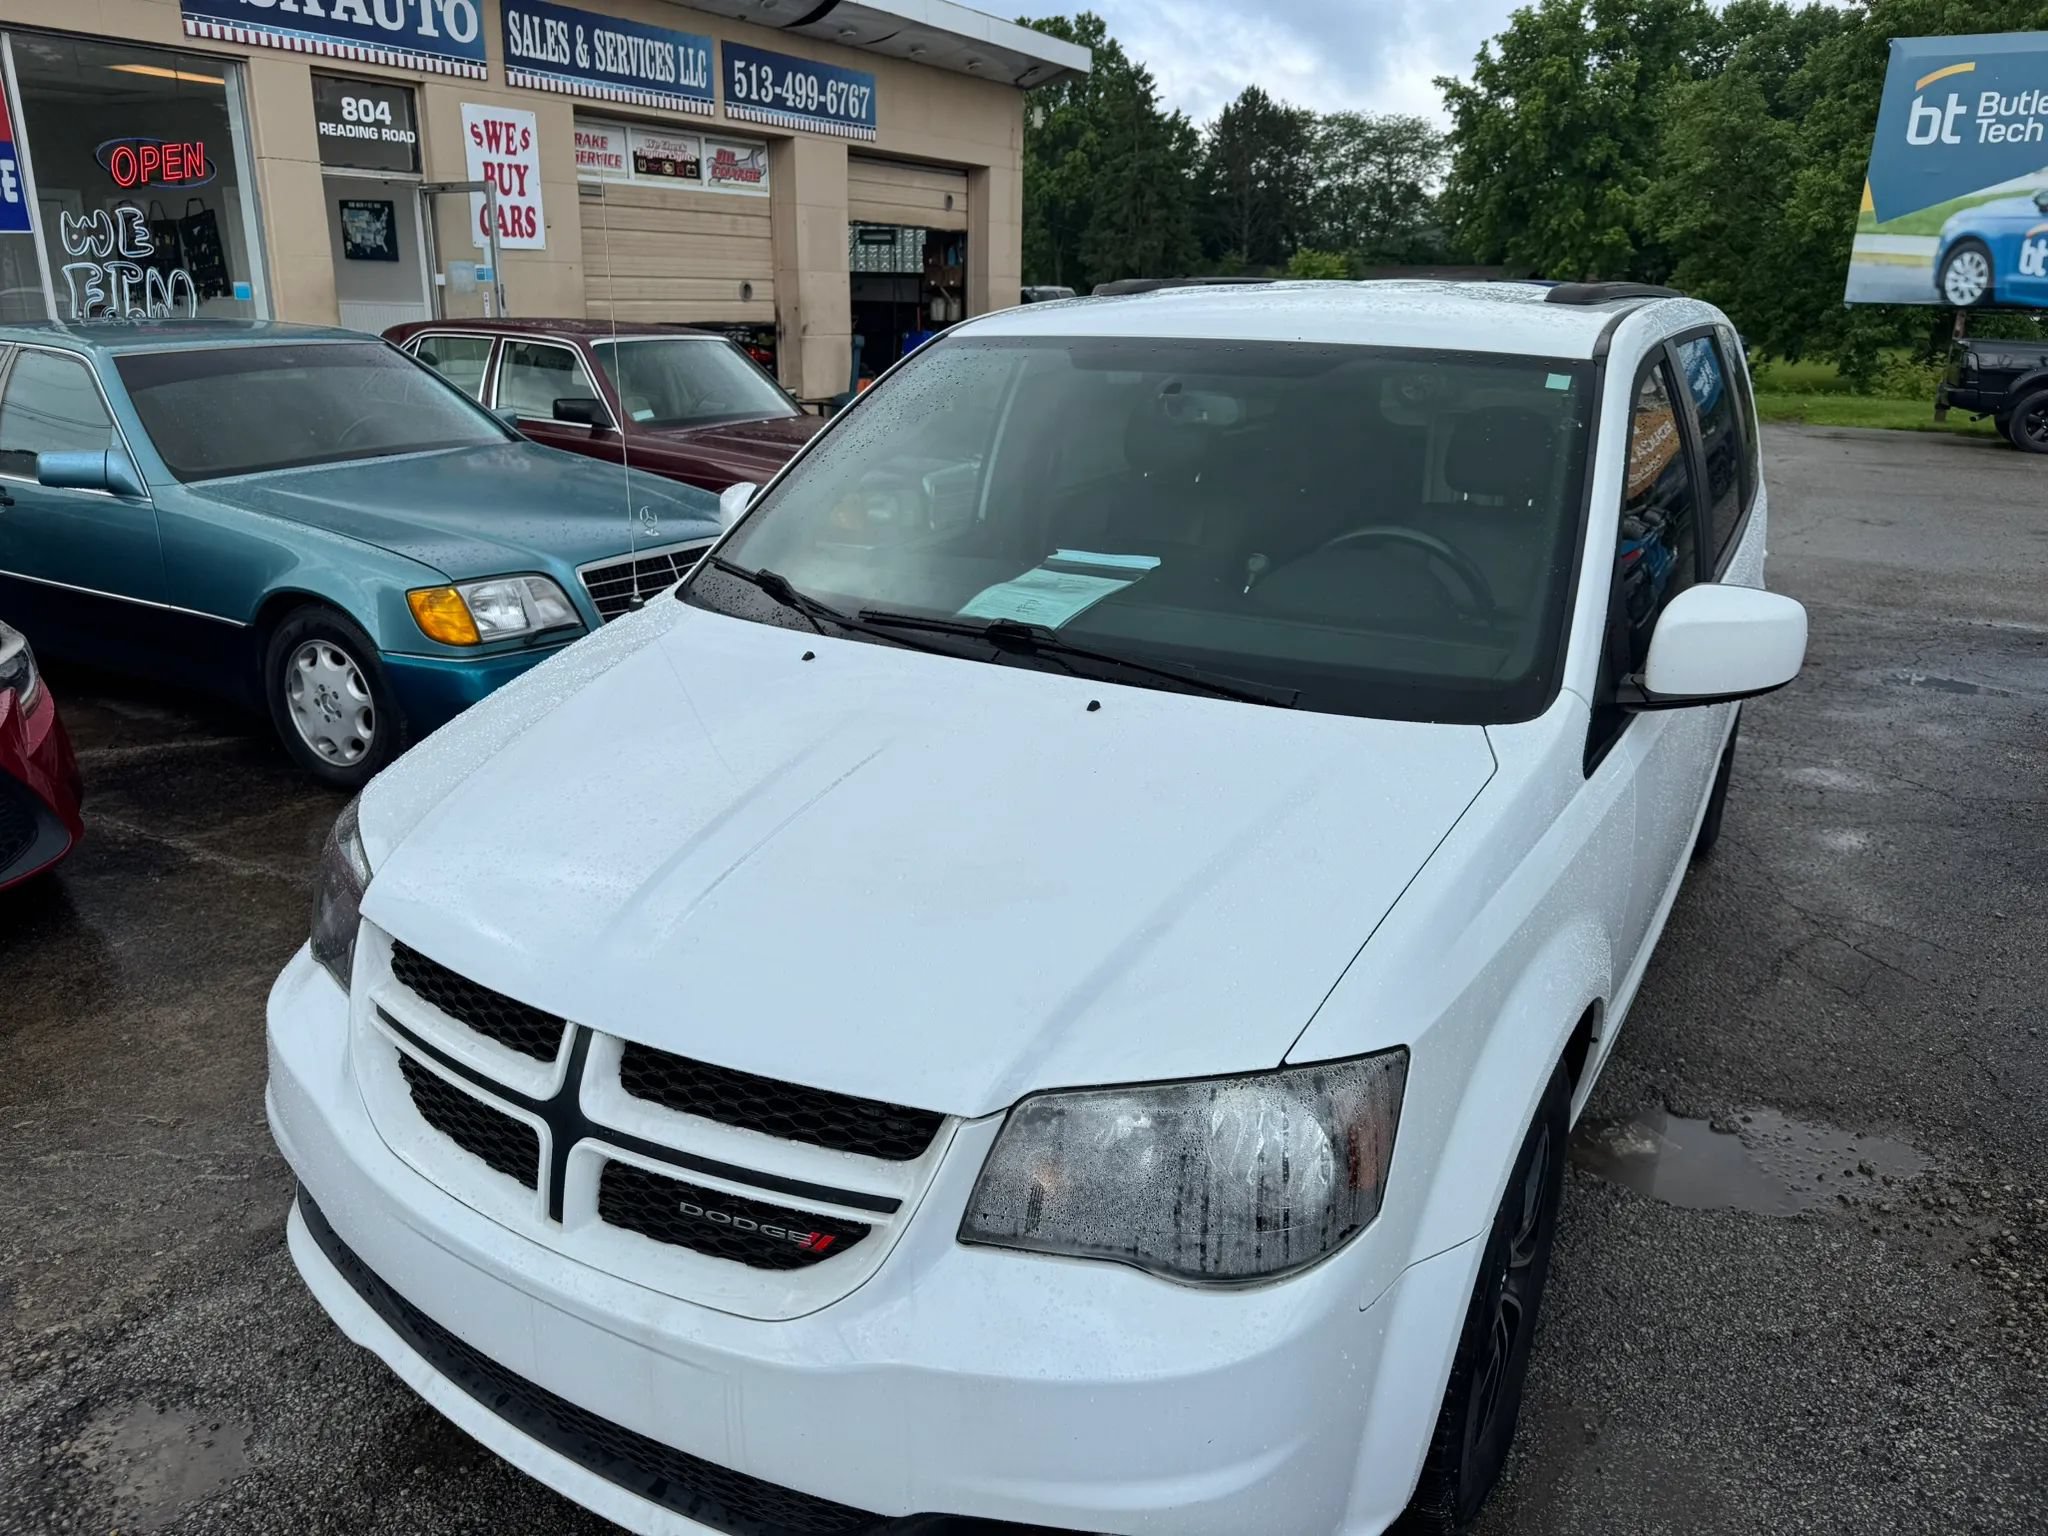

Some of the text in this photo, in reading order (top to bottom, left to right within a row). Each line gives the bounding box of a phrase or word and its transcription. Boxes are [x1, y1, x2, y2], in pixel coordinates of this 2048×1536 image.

[330, 0, 478, 43] AUTO
[507, 10, 707, 89] SALES & SERVICES LLC
[341, 96, 392, 125] 804
[733, 60, 870, 119] 513-499-6767
[1977, 90, 2048, 117] Butle
[319, 122, 416, 144] READING ROAD
[1906, 93, 1967, 146] bt
[1976, 117, 2042, 144] Tech
[0, 159, 19, 203] E
[111, 142, 205, 186] OPEN
[482, 162, 529, 197] BUY
[61, 207, 155, 258] WE
[480, 205, 537, 238] CARS
[679, 1202, 813, 1246] DODGE
